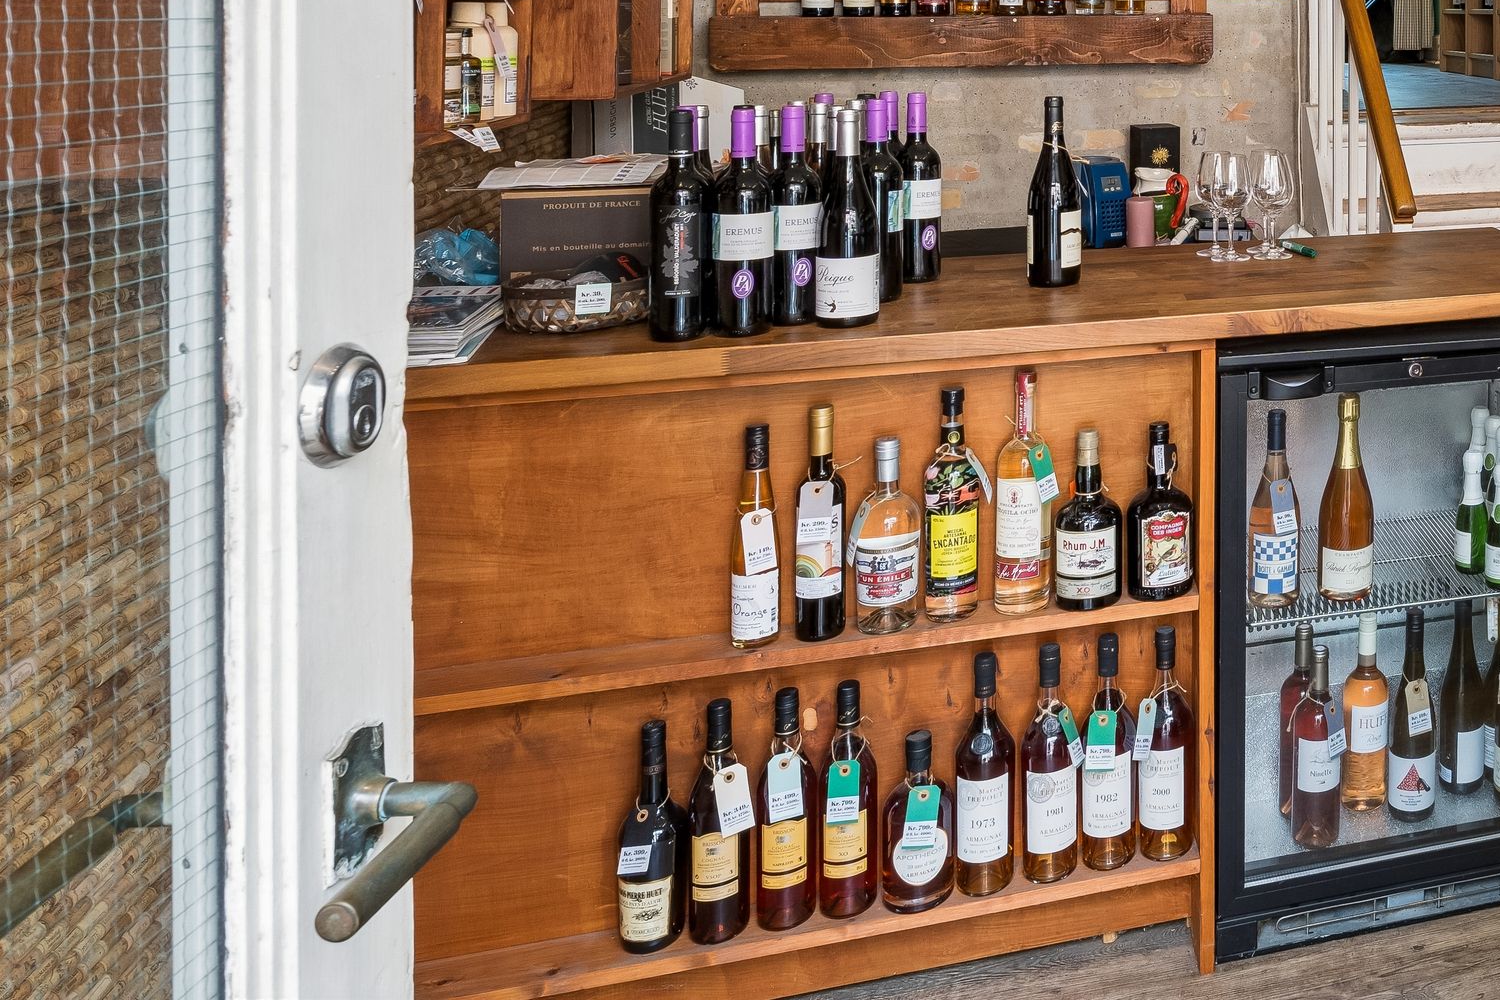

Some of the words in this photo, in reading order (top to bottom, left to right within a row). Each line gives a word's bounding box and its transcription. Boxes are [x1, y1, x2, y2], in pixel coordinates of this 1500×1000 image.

[543, 202, 586, 210] PRODUIT
[604, 200, 642, 208] FRANCE
[726, 226, 763, 236] EREMUS
[532, 244, 548, 252] Mis
[563, 243, 602, 251] bouteille
[818, 264, 854, 286] Peique
[736, 276, 750, 293] PA
[1151, 521, 1184, 530] COMPAGNIE
[933, 534, 976, 550] ENCANTADO
[1063, 540, 1087, 551] Rhum
[1090, 538, 1105, 550] J.M
[1156, 757, 1180, 765] Marcel
[979, 784, 1004, 794] Marcel
[1152, 788, 1170, 796] 2000
[1095, 793, 1118, 803] 1982
[971, 817, 996, 829] 1973
[966, 833, 1002, 842] ARMAGNAC
[628, 889, 646, 899] PIERRE
[646, 888, 663, 898] HUET
